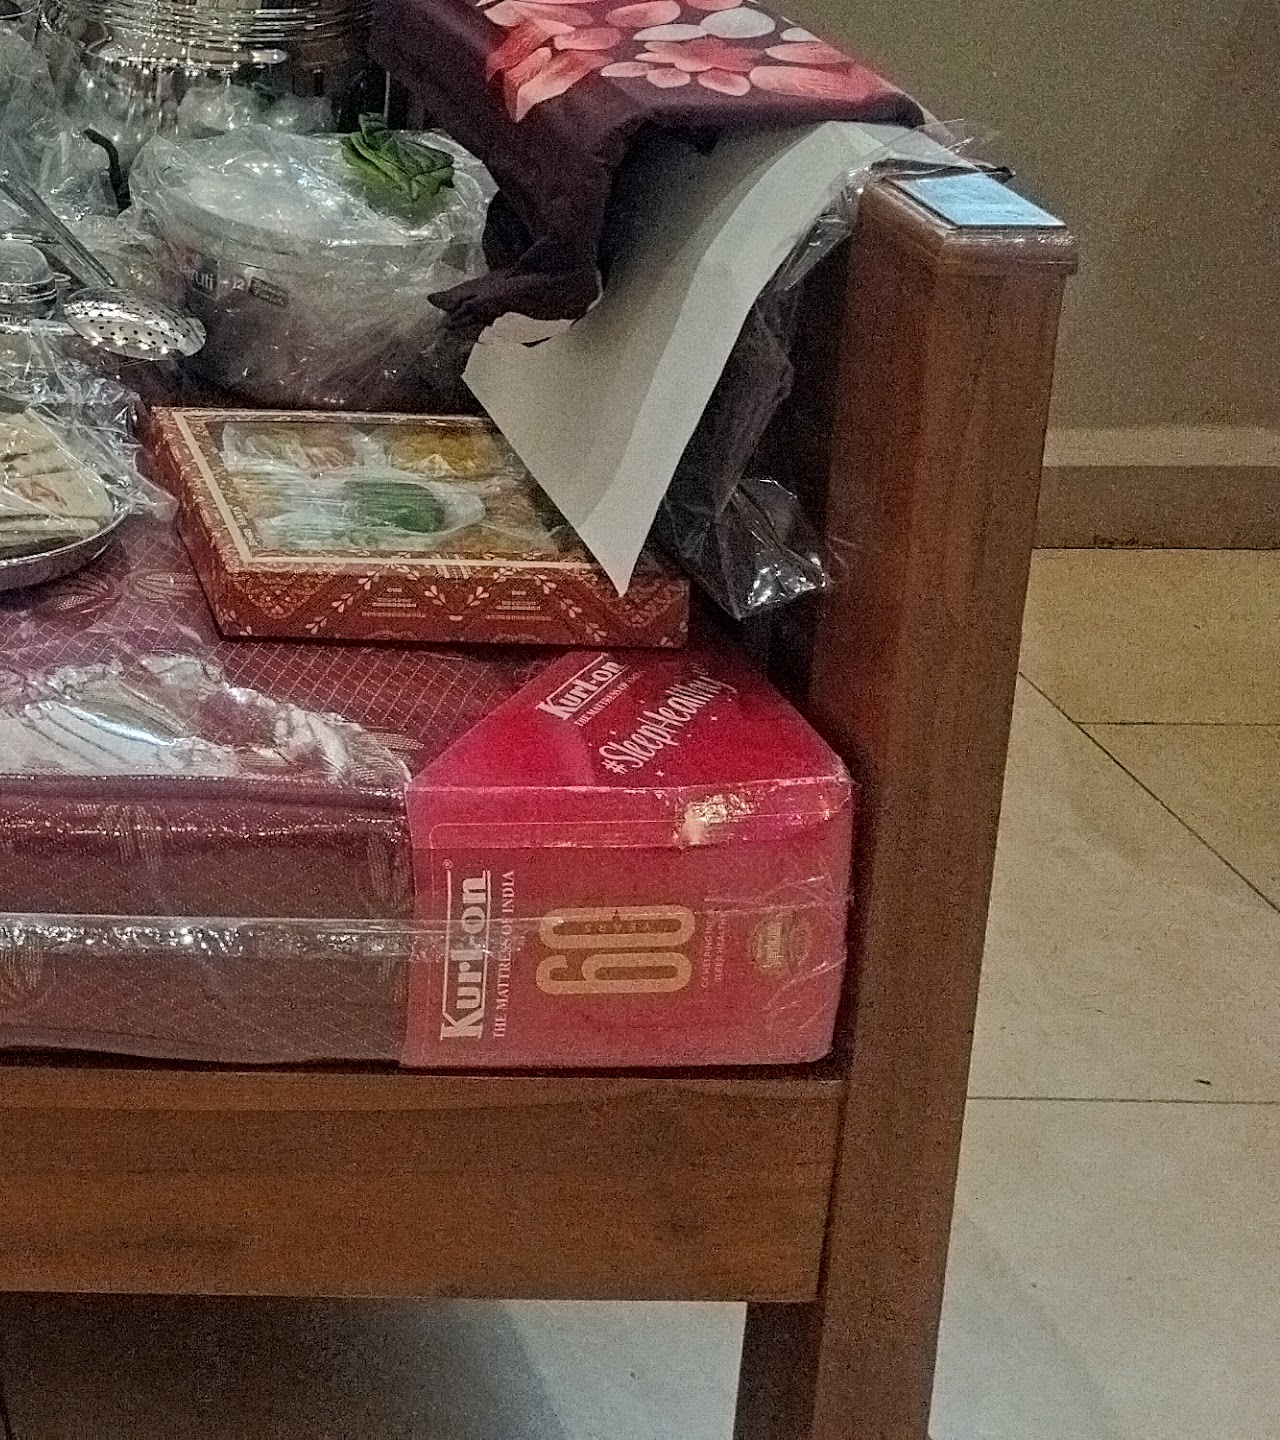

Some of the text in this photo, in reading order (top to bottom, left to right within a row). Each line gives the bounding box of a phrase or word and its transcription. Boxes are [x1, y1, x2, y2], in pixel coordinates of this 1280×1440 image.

[534, 660, 626, 721] Kurl-on
[439, 869, 490, 1042] Kurl-on
[492, 1013, 509, 1038] THE
[501, 869, 516, 913] INDIA
